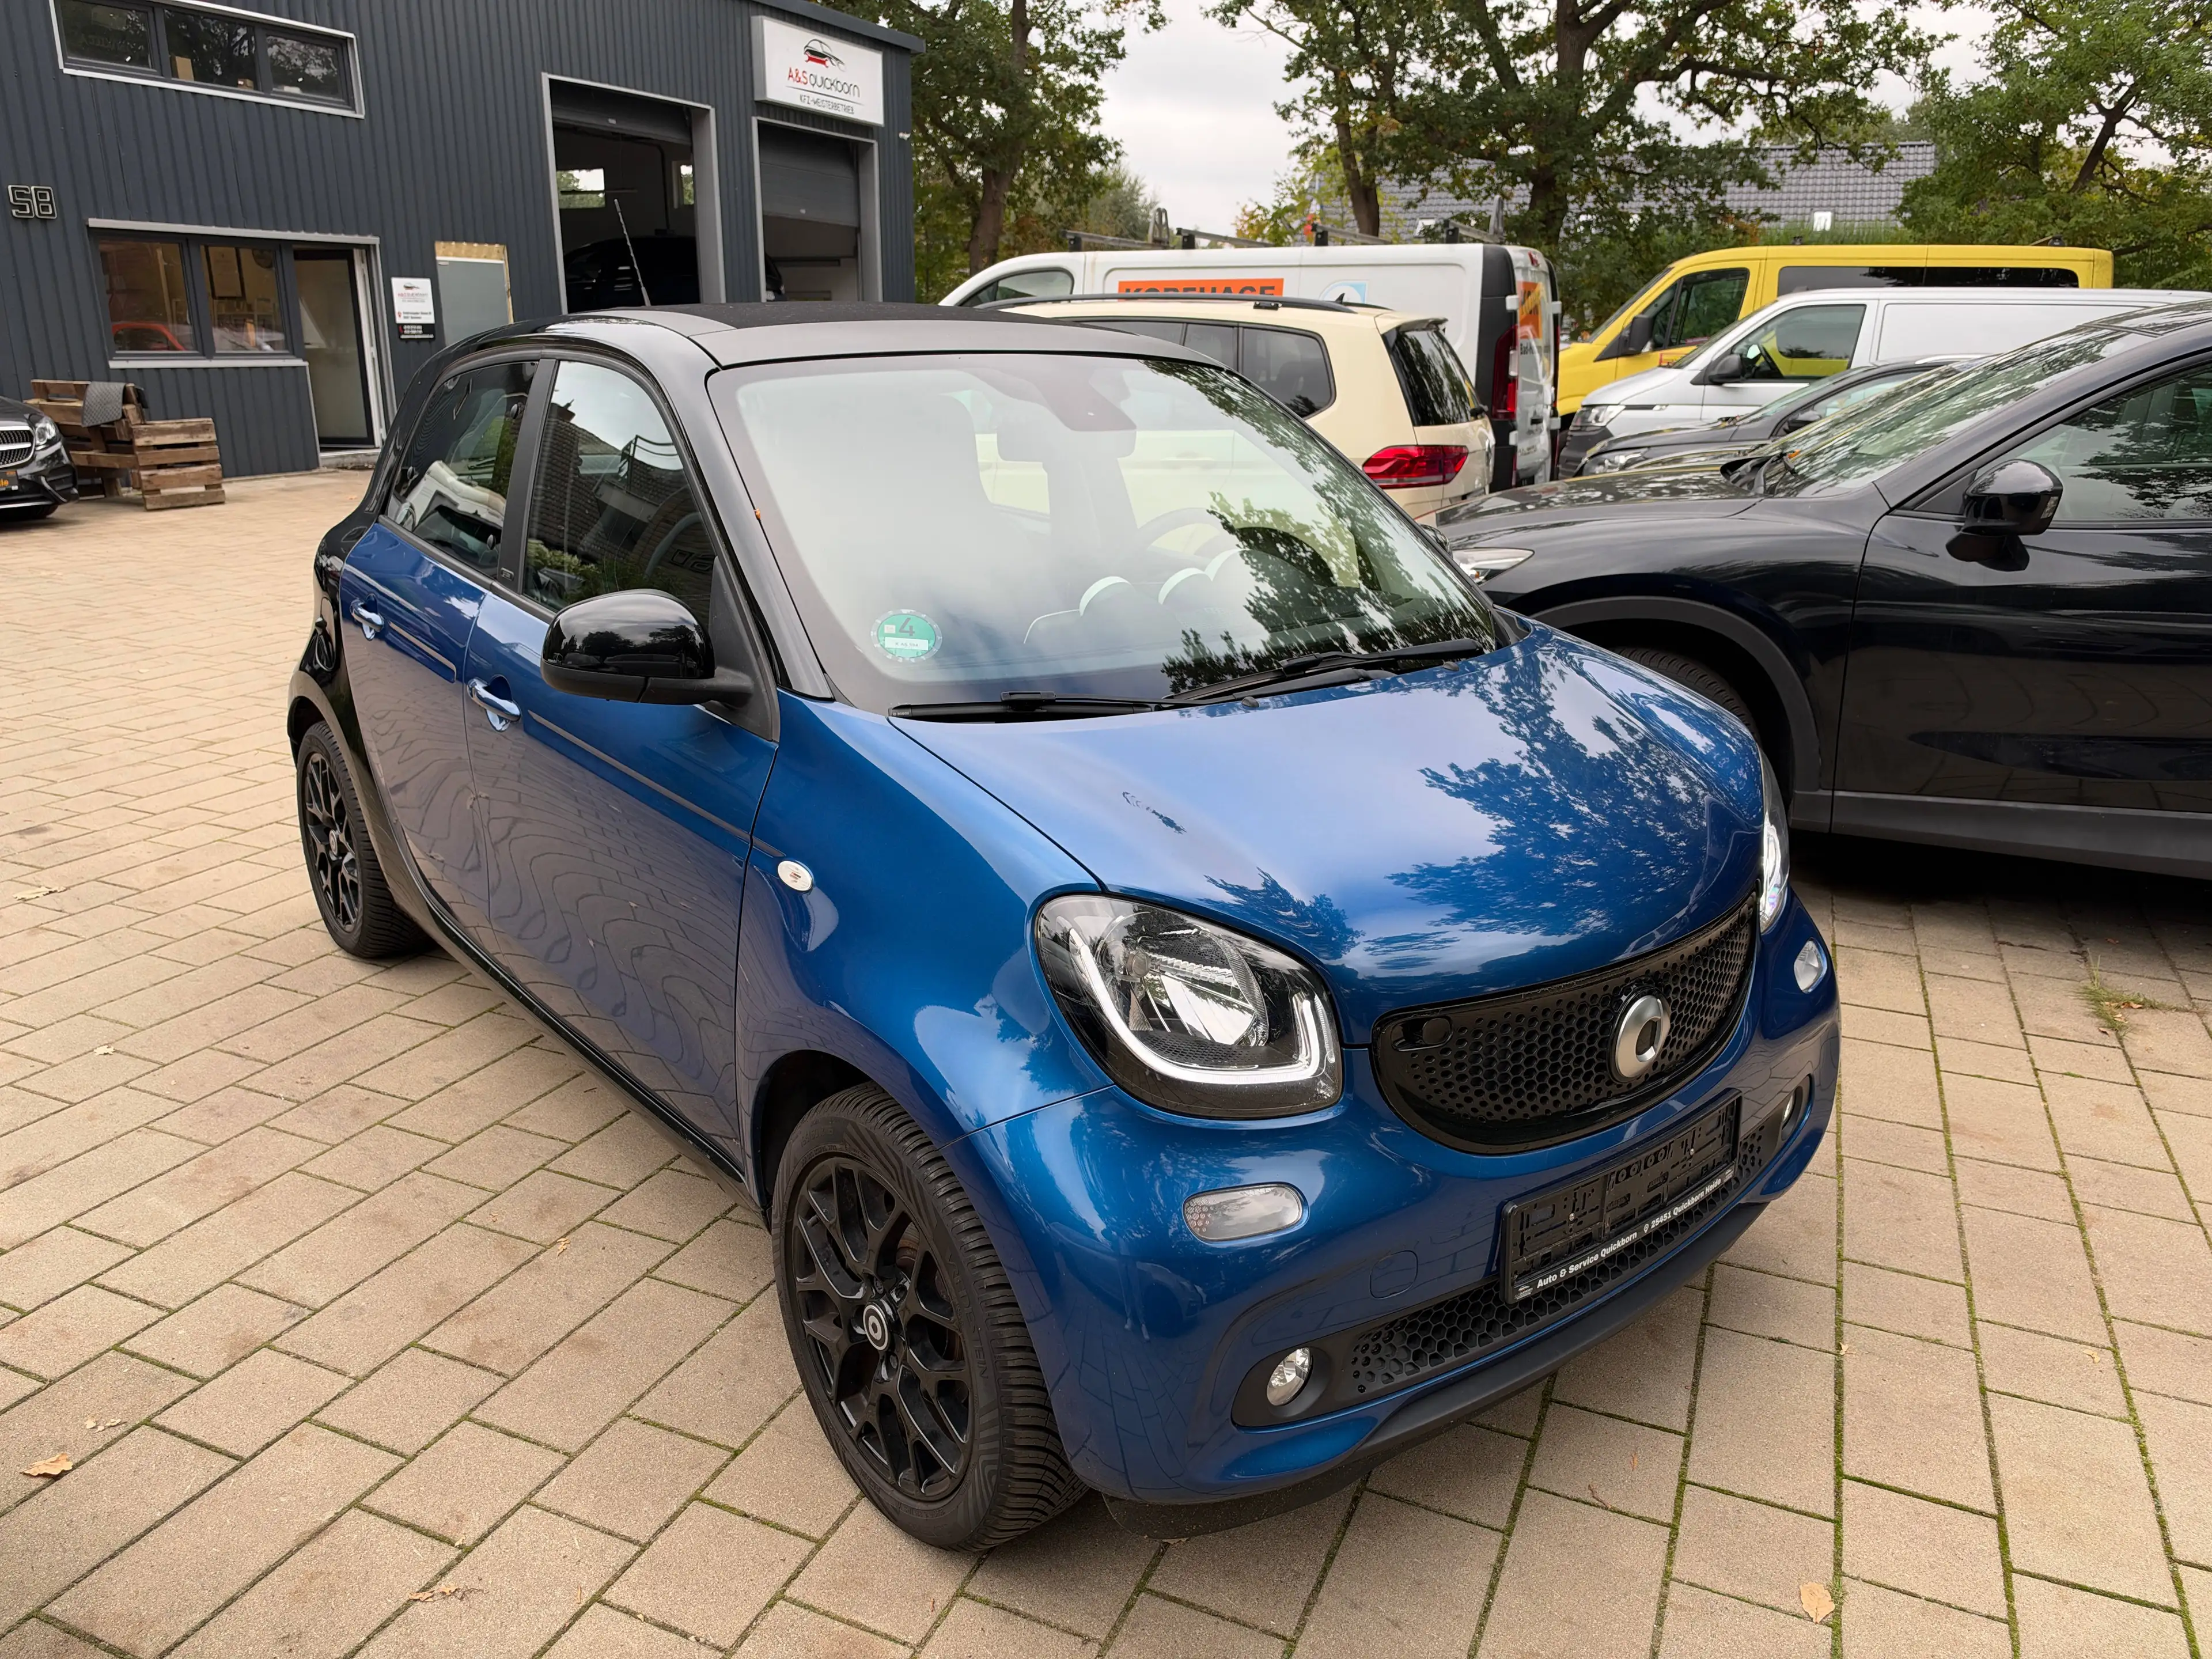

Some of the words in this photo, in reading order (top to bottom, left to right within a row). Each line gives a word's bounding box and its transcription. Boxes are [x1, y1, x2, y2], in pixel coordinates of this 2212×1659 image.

[787, 67, 808, 85] A&S
[899, 618, 915, 637] 4
[1537, 1274, 1558, 1289] Auto
[1559, 1268, 1567, 1278] &
[1569, 1253, 1599, 1274] Service
[1600, 1232, 1638, 1257] Quickborn
[1650, 1210, 1672, 1229] 25451
[1673, 1191, 1704, 1215] Quickborn
